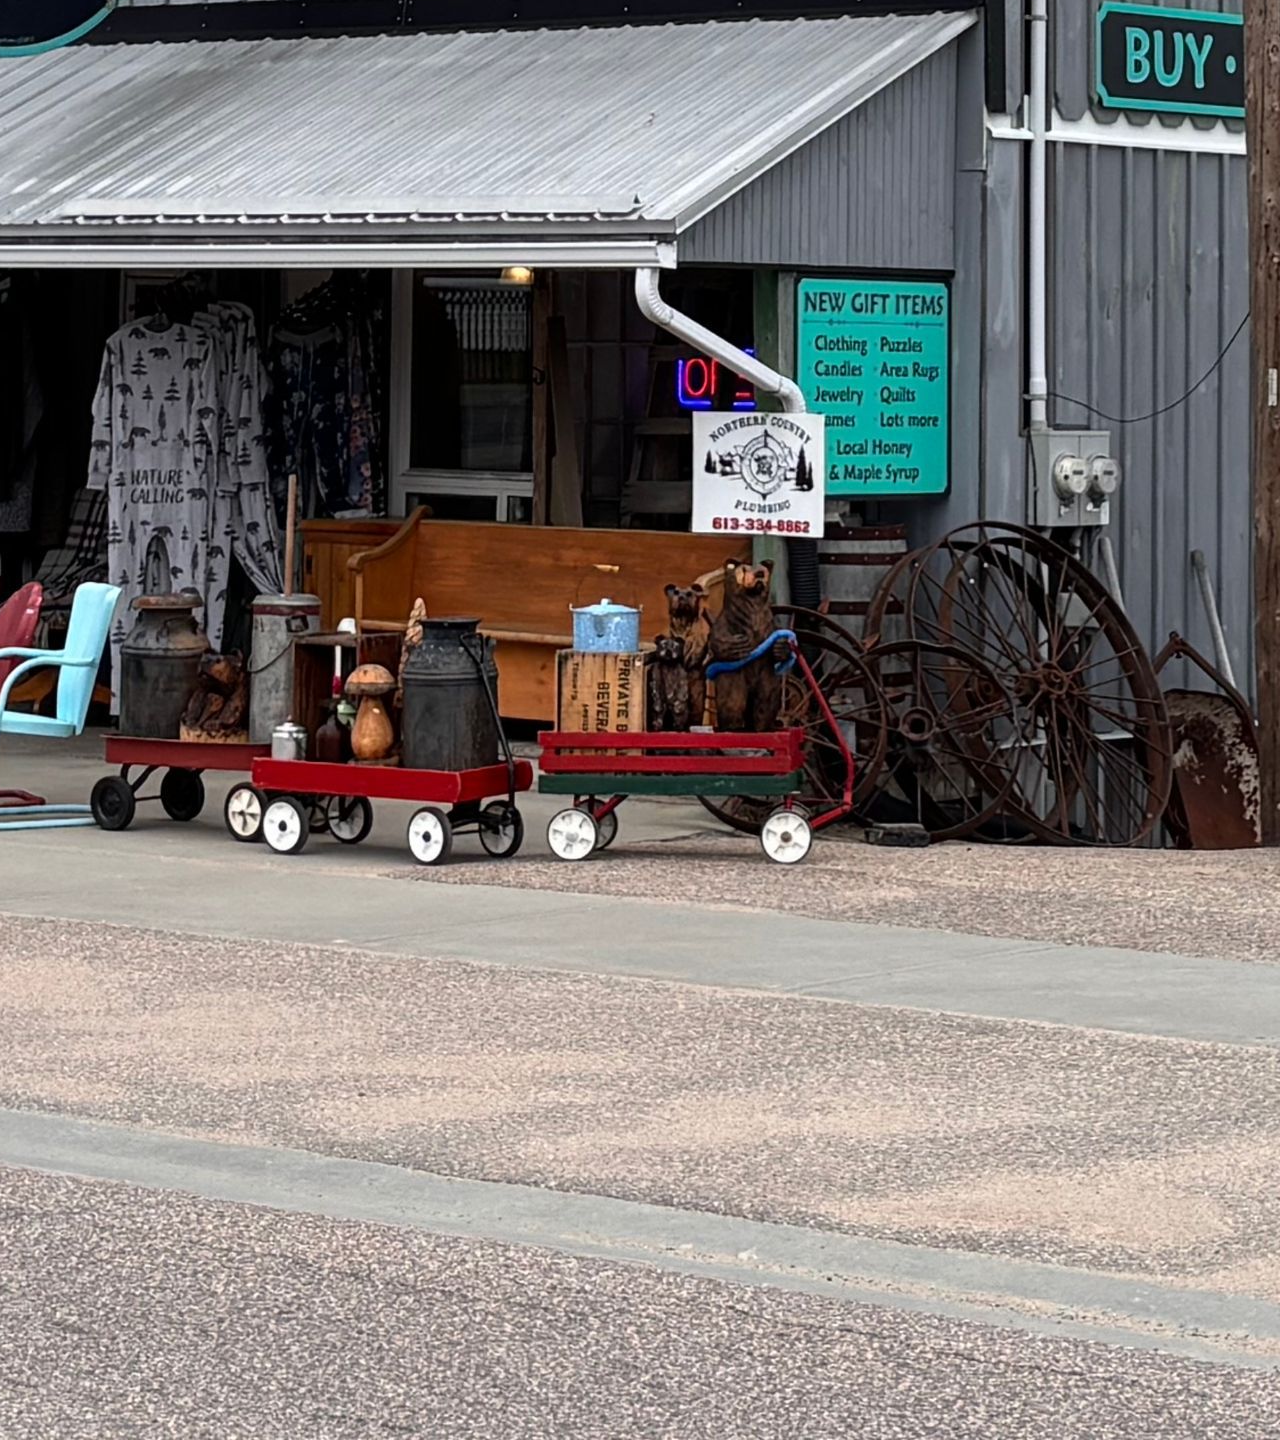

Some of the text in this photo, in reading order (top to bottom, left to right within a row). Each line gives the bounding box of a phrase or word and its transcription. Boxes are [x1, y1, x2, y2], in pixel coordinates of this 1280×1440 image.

[1125, 26, 1214, 89] BUY
[805, 292, 944, 315] NEW GIFT ITEMS
[814, 335, 867, 356] Clothing
[880, 337, 923, 352] Puzzles
[814, 360, 863, 377] Candles
[880, 362, 940, 381] Area Rugs
[814, 386, 863, 406] Jewelry
[880, 386, 916, 404] Quilts
[824, 414, 855, 427] ames
[880, 412, 939, 427] Lots more
[709, 416, 812, 444] NORTHERN COUNTRY
[837, 439, 913, 458] Local Honey
[131, 468, 183, 487] NATURE
[829, 464, 920, 483] & Maple Syrup
[131, 488, 184, 504] CALLING
[734, 499, 791, 514] PLUMBING
[617, 658, 631, 718] PRIVATE
